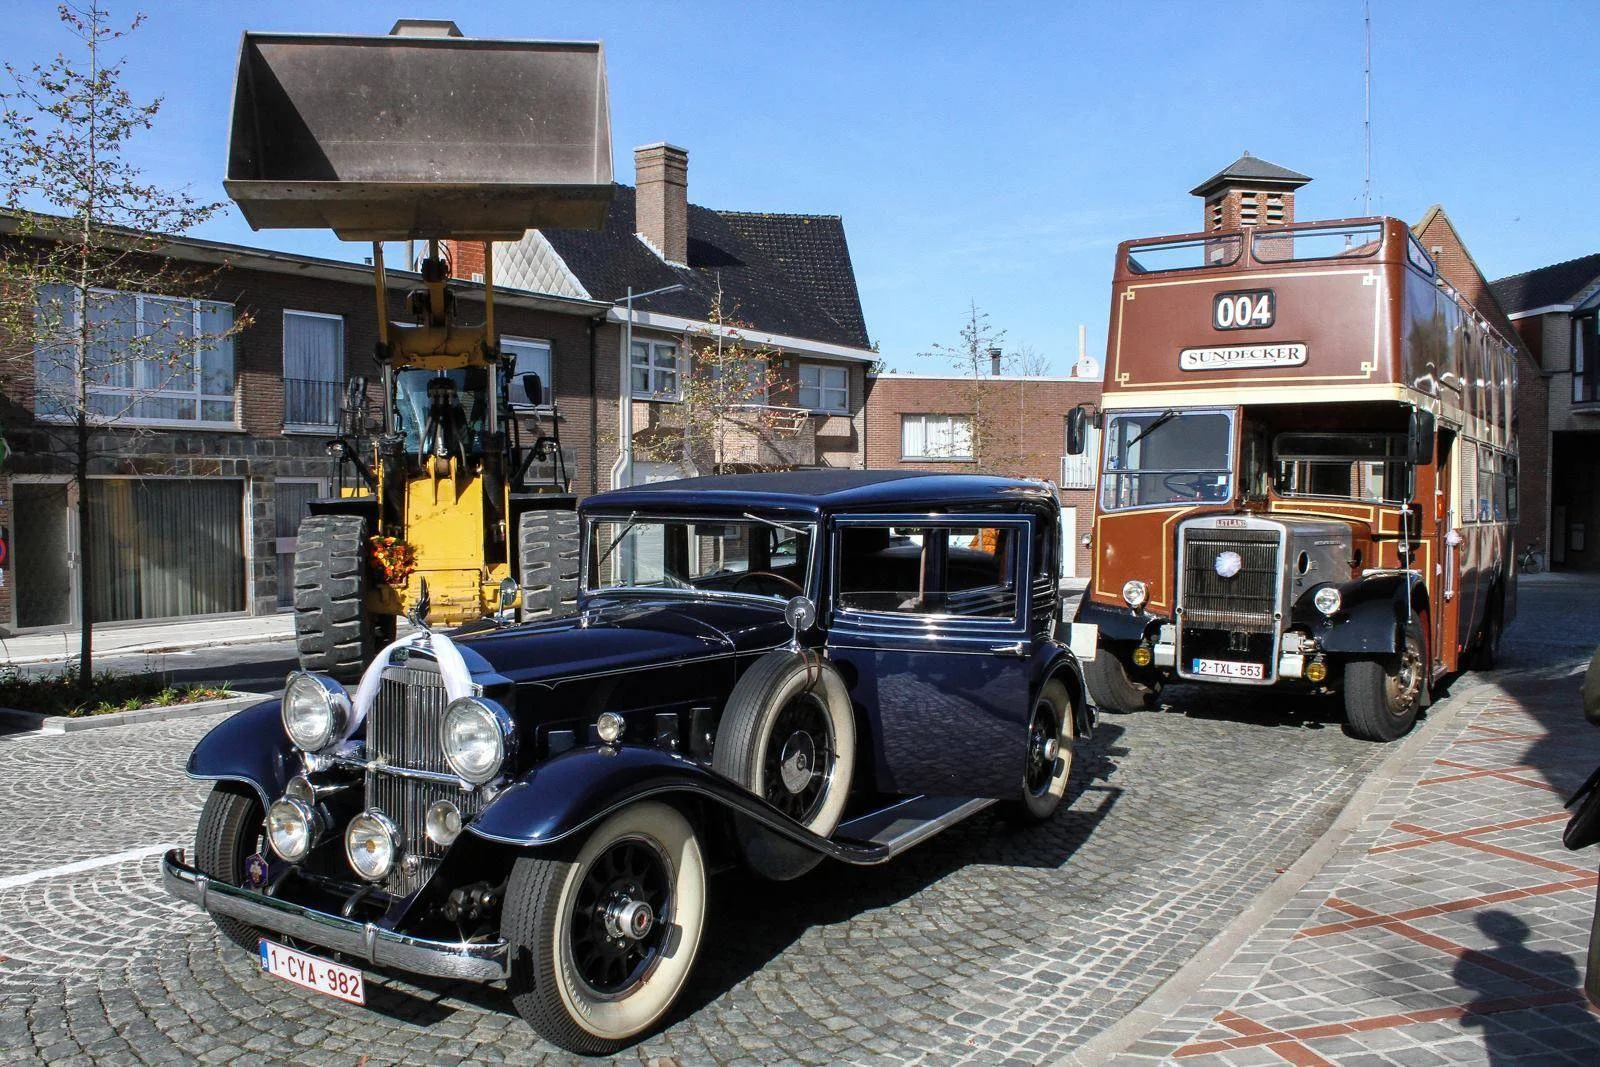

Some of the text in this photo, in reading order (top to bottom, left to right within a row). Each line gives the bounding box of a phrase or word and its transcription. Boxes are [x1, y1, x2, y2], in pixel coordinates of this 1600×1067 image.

[1217, 295, 1271, 327] 004
[1189, 347, 1300, 364] SUNDECKER
[1201, 661, 1261, 677] 2-TXL-553
[271, 950, 361, 998] 1-CYA-982
